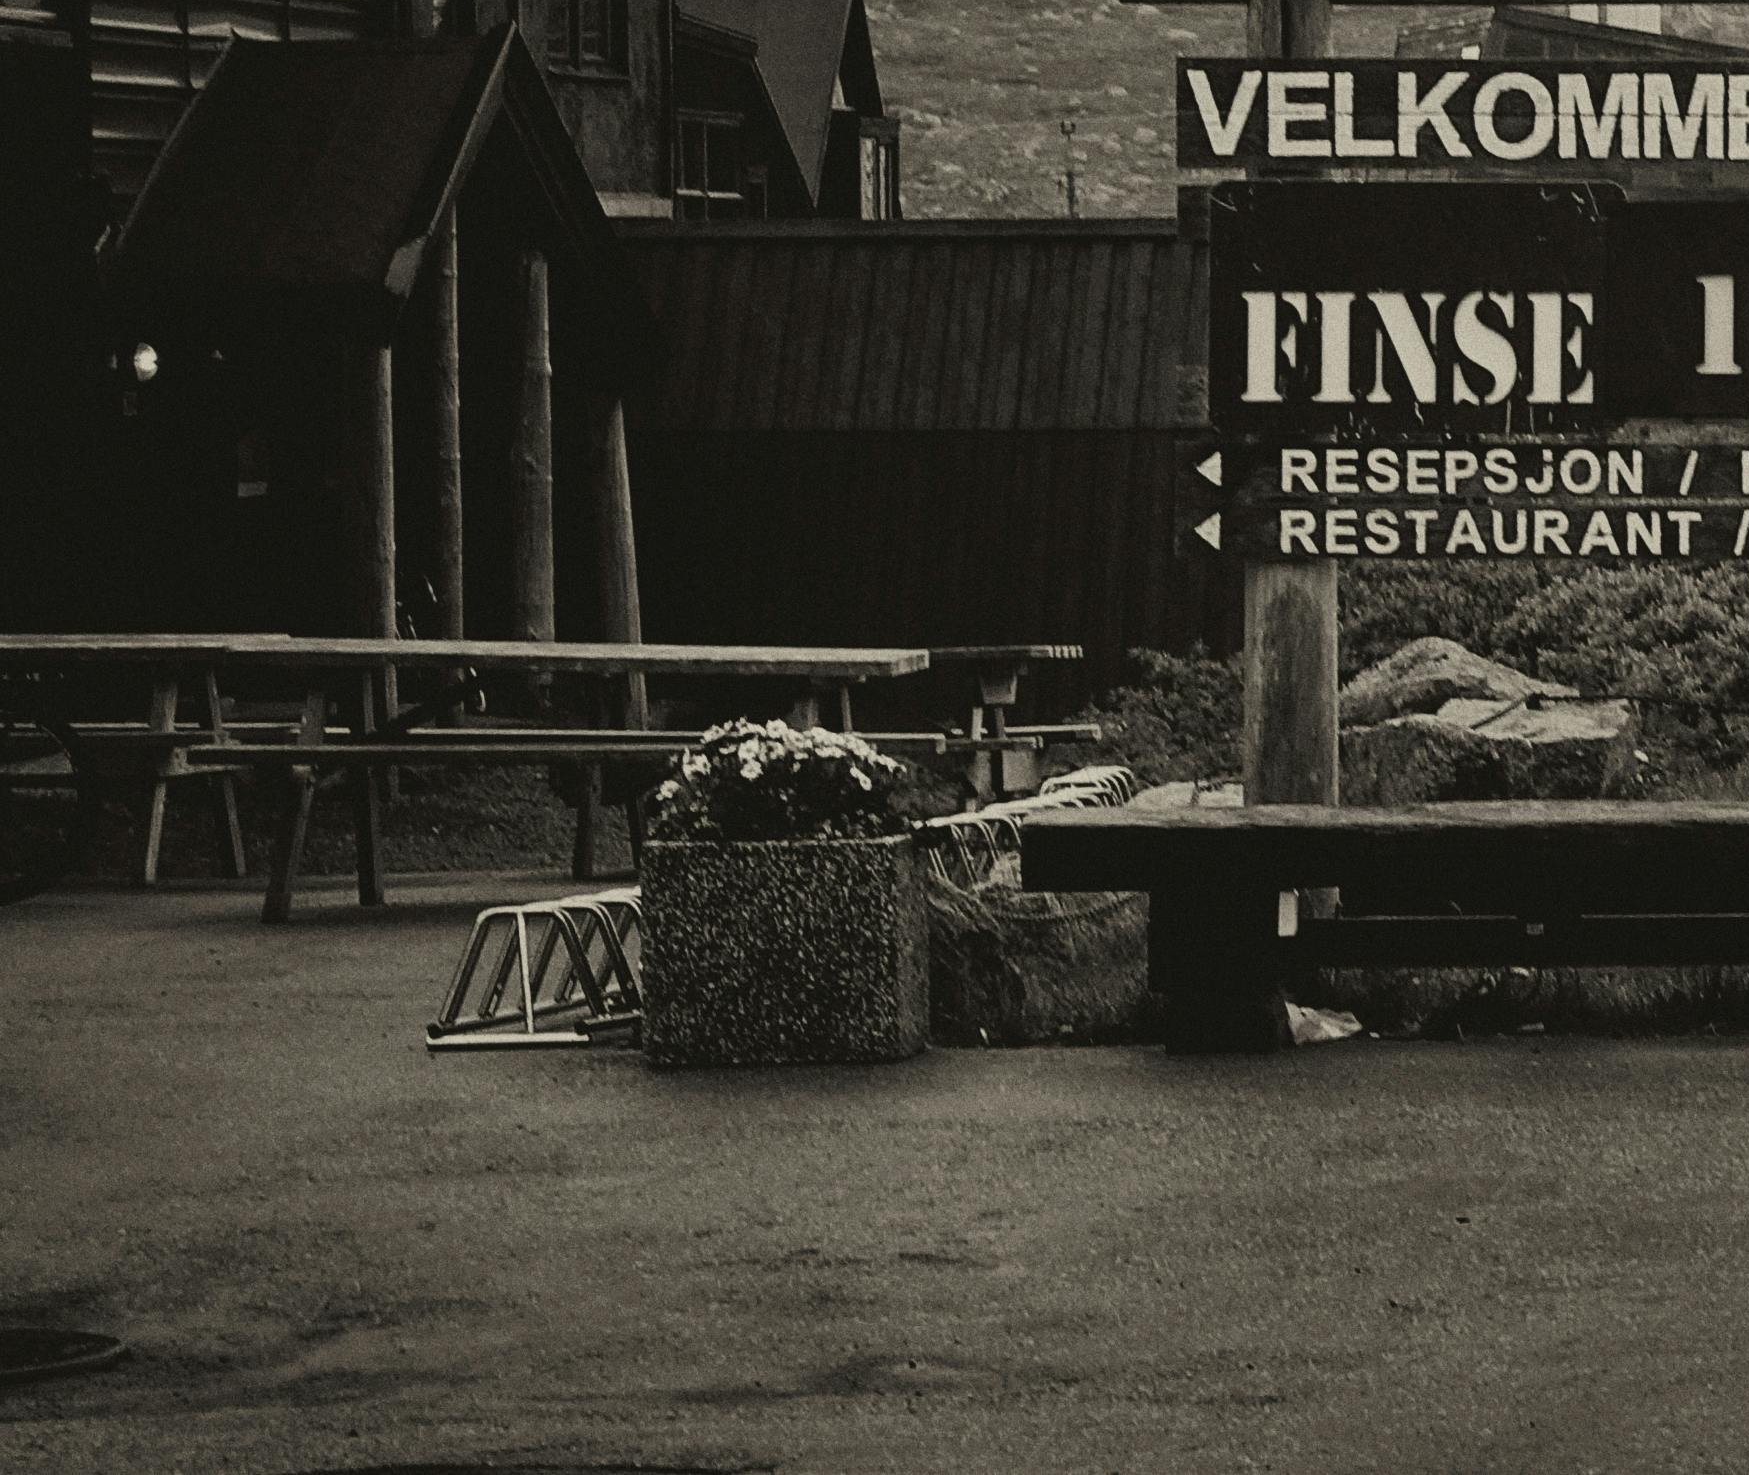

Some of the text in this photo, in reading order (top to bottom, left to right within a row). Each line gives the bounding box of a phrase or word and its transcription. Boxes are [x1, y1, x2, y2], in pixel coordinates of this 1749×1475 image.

[1240, 291, 1595, 405] FINSE
[1280, 448, 1644, 496] RESEPSJON
[1280, 509, 1702, 556] RESTAURANT
